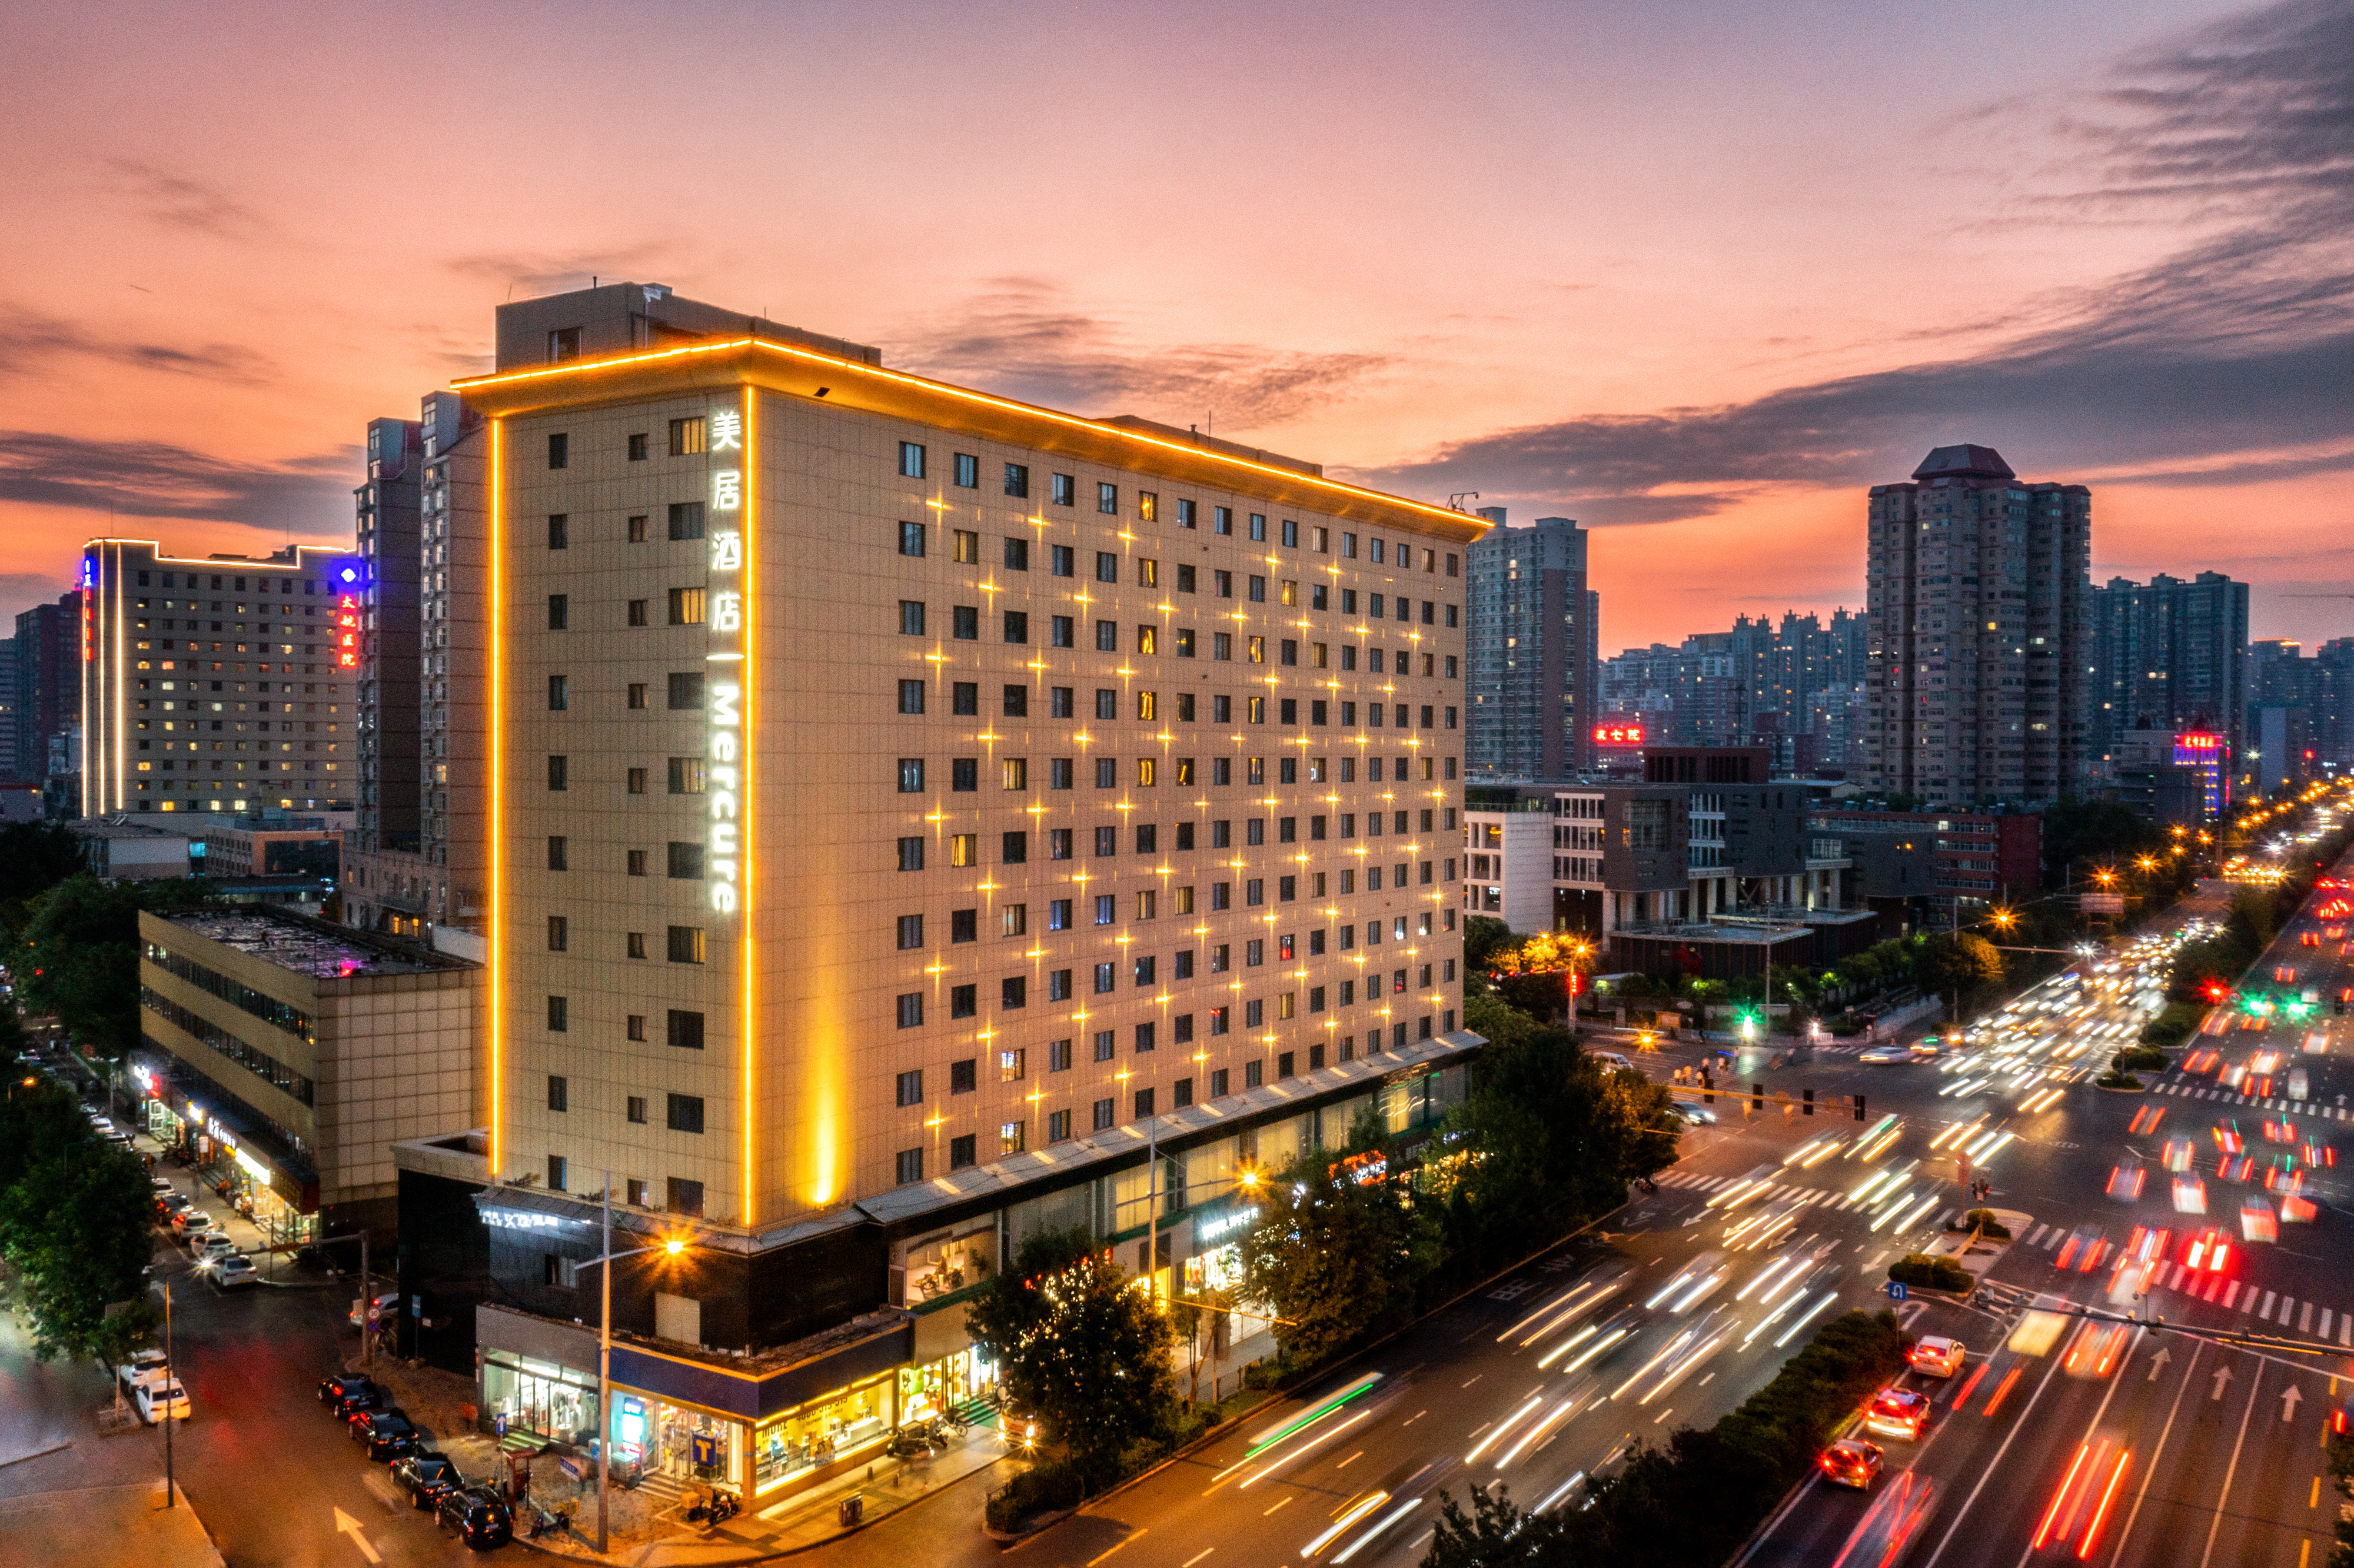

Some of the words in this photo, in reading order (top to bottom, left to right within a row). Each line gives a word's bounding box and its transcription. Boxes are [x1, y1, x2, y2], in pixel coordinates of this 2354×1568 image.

[712, 411, 740, 630] 美居酒店
[711, 684, 739, 911] Mercure
